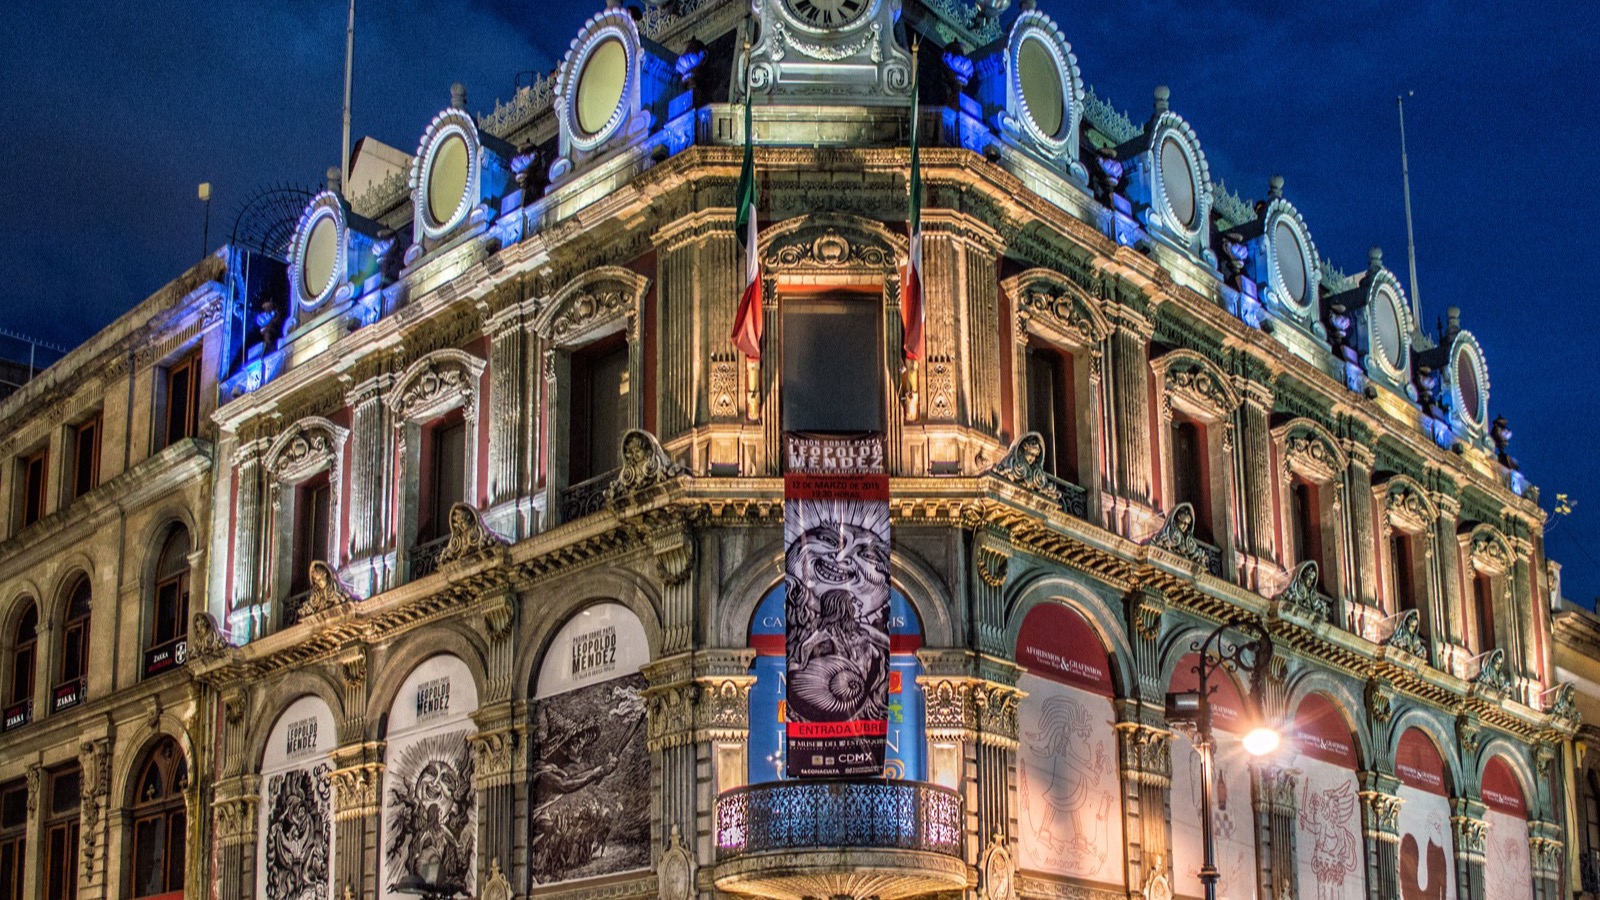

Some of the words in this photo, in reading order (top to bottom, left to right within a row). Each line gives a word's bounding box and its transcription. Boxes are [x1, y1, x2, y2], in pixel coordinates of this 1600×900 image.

[788, 444, 883, 459] LEOPOLDO
[815, 481, 847, 489] MARZO
[573, 633, 617, 659] LEOPOLDO
[572, 647, 616, 674] MENDEZ
[1026, 645, 1061, 662] AFORISMOS
[1060, 656, 1070, 672] &
[1069, 660, 1103, 677] GRAFISMOS
[417, 682, 451, 703] LEOPOLDO
[287, 722, 318, 743] LEOPOLDO
[799, 724, 852, 735] ENTRADA
[854, 723, 885, 733] LIBRE
[839, 752, 872, 763] CDMX
